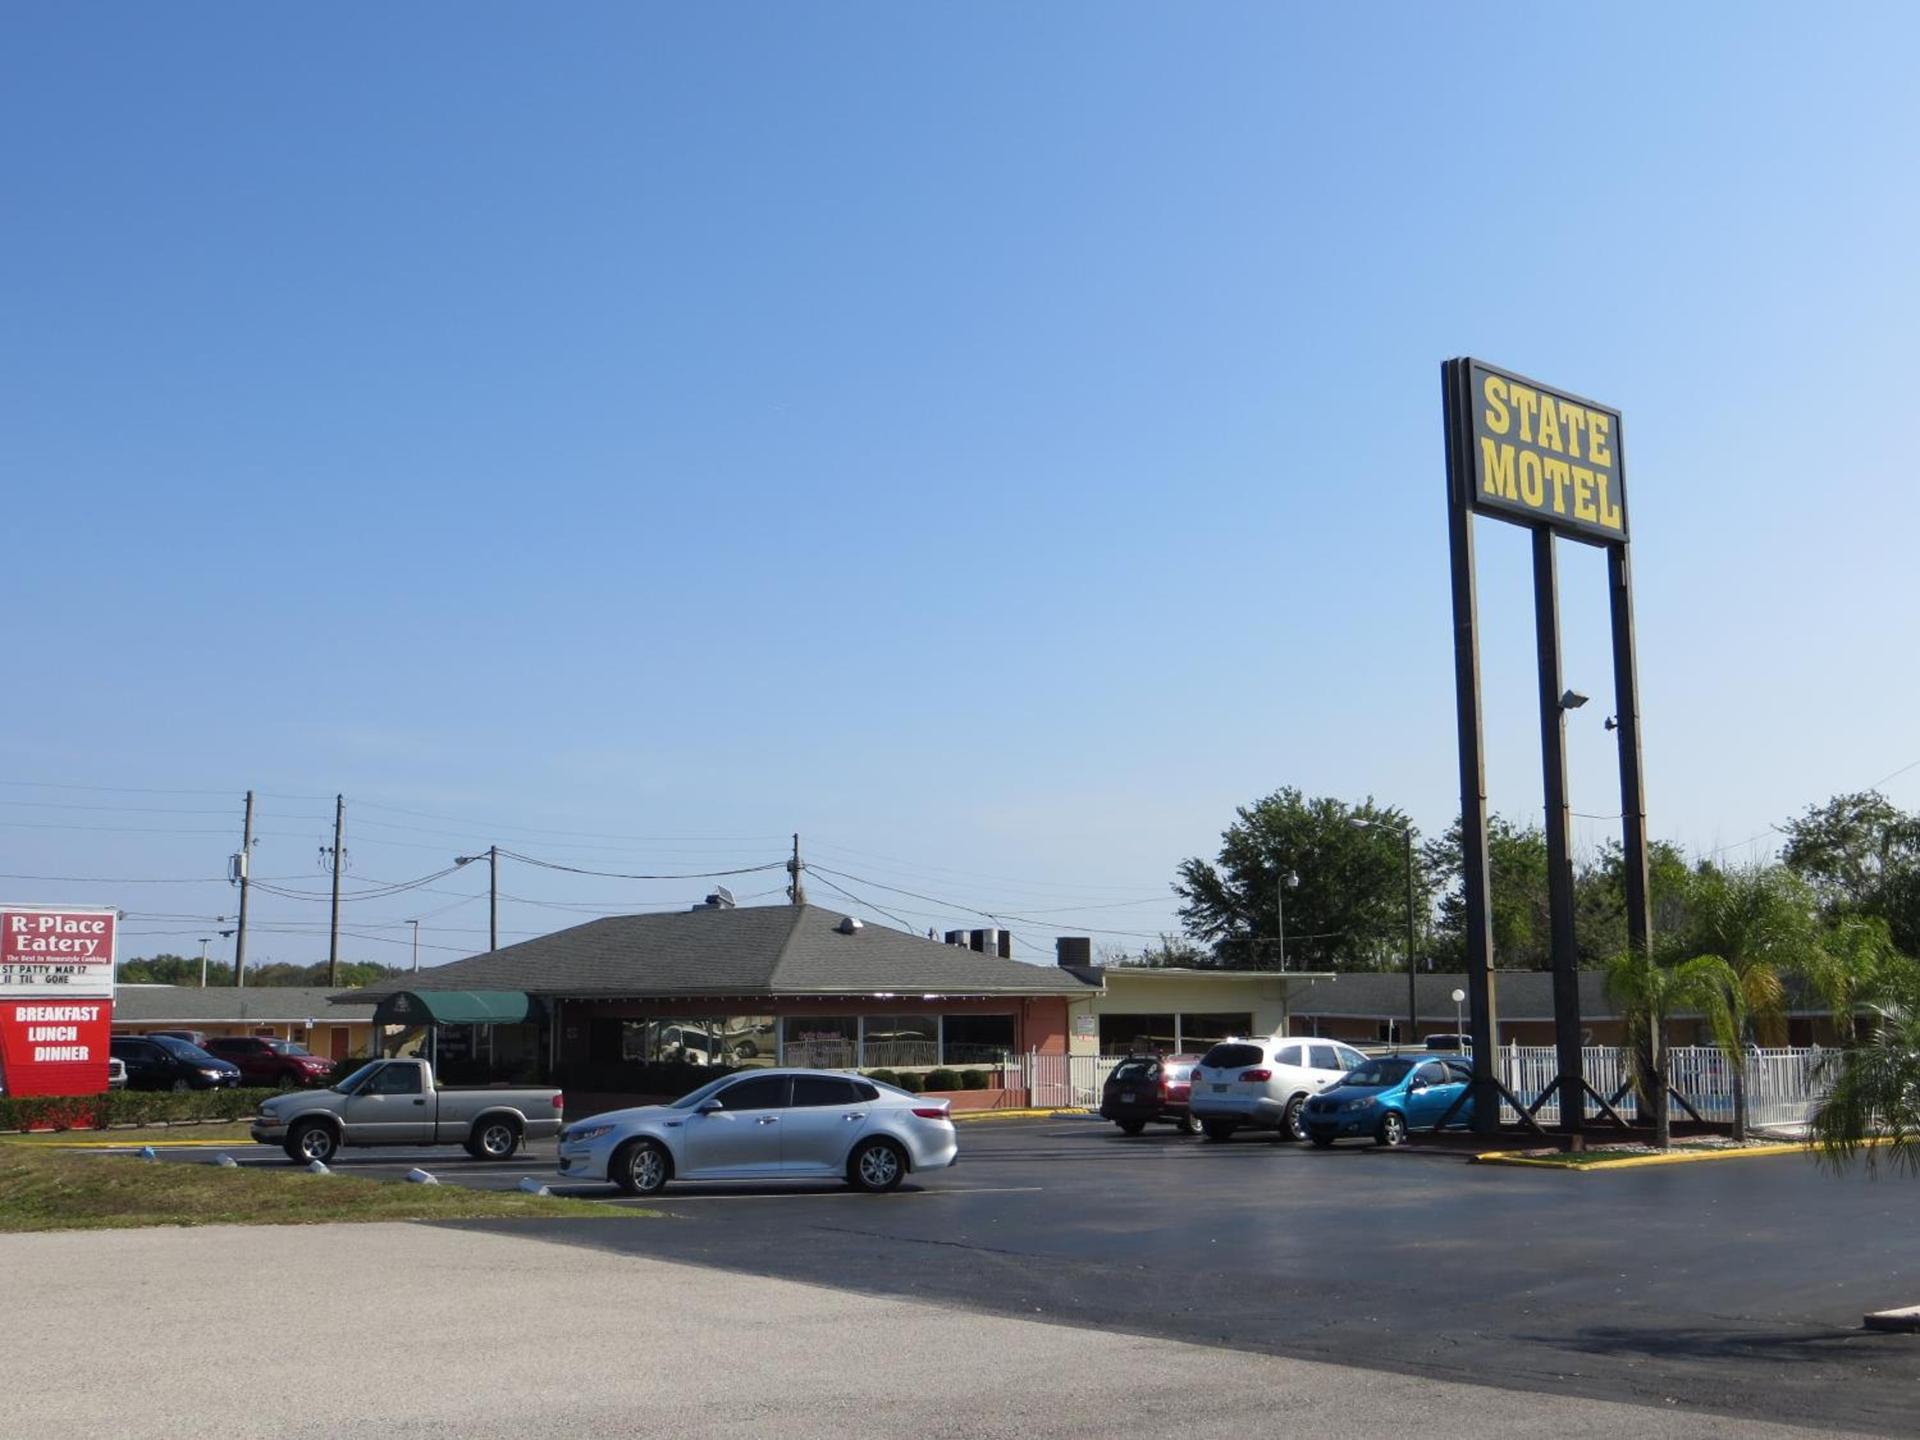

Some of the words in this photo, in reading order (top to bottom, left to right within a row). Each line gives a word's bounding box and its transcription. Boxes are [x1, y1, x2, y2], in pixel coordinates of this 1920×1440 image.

[1484, 376, 1611, 468] STATE
[1481, 436, 1620, 529] MOTEL
[11, 915, 105, 934] R-Place
[16, 935, 99, 956] Eatery
[2, 965, 14, 974] ST
[20, 966, 50, 974] PATTY
[55, 966, 75, 974] MAR
[77, 966, 87, 975] 17
[20, 975, 34, 984] TIL
[45, 975, 69, 984] GONE
[16, 1006, 100, 1022] BREAKFAST
[28, 1026, 77, 1042] LUNCH
[34, 1046, 90, 1062] DINNER
